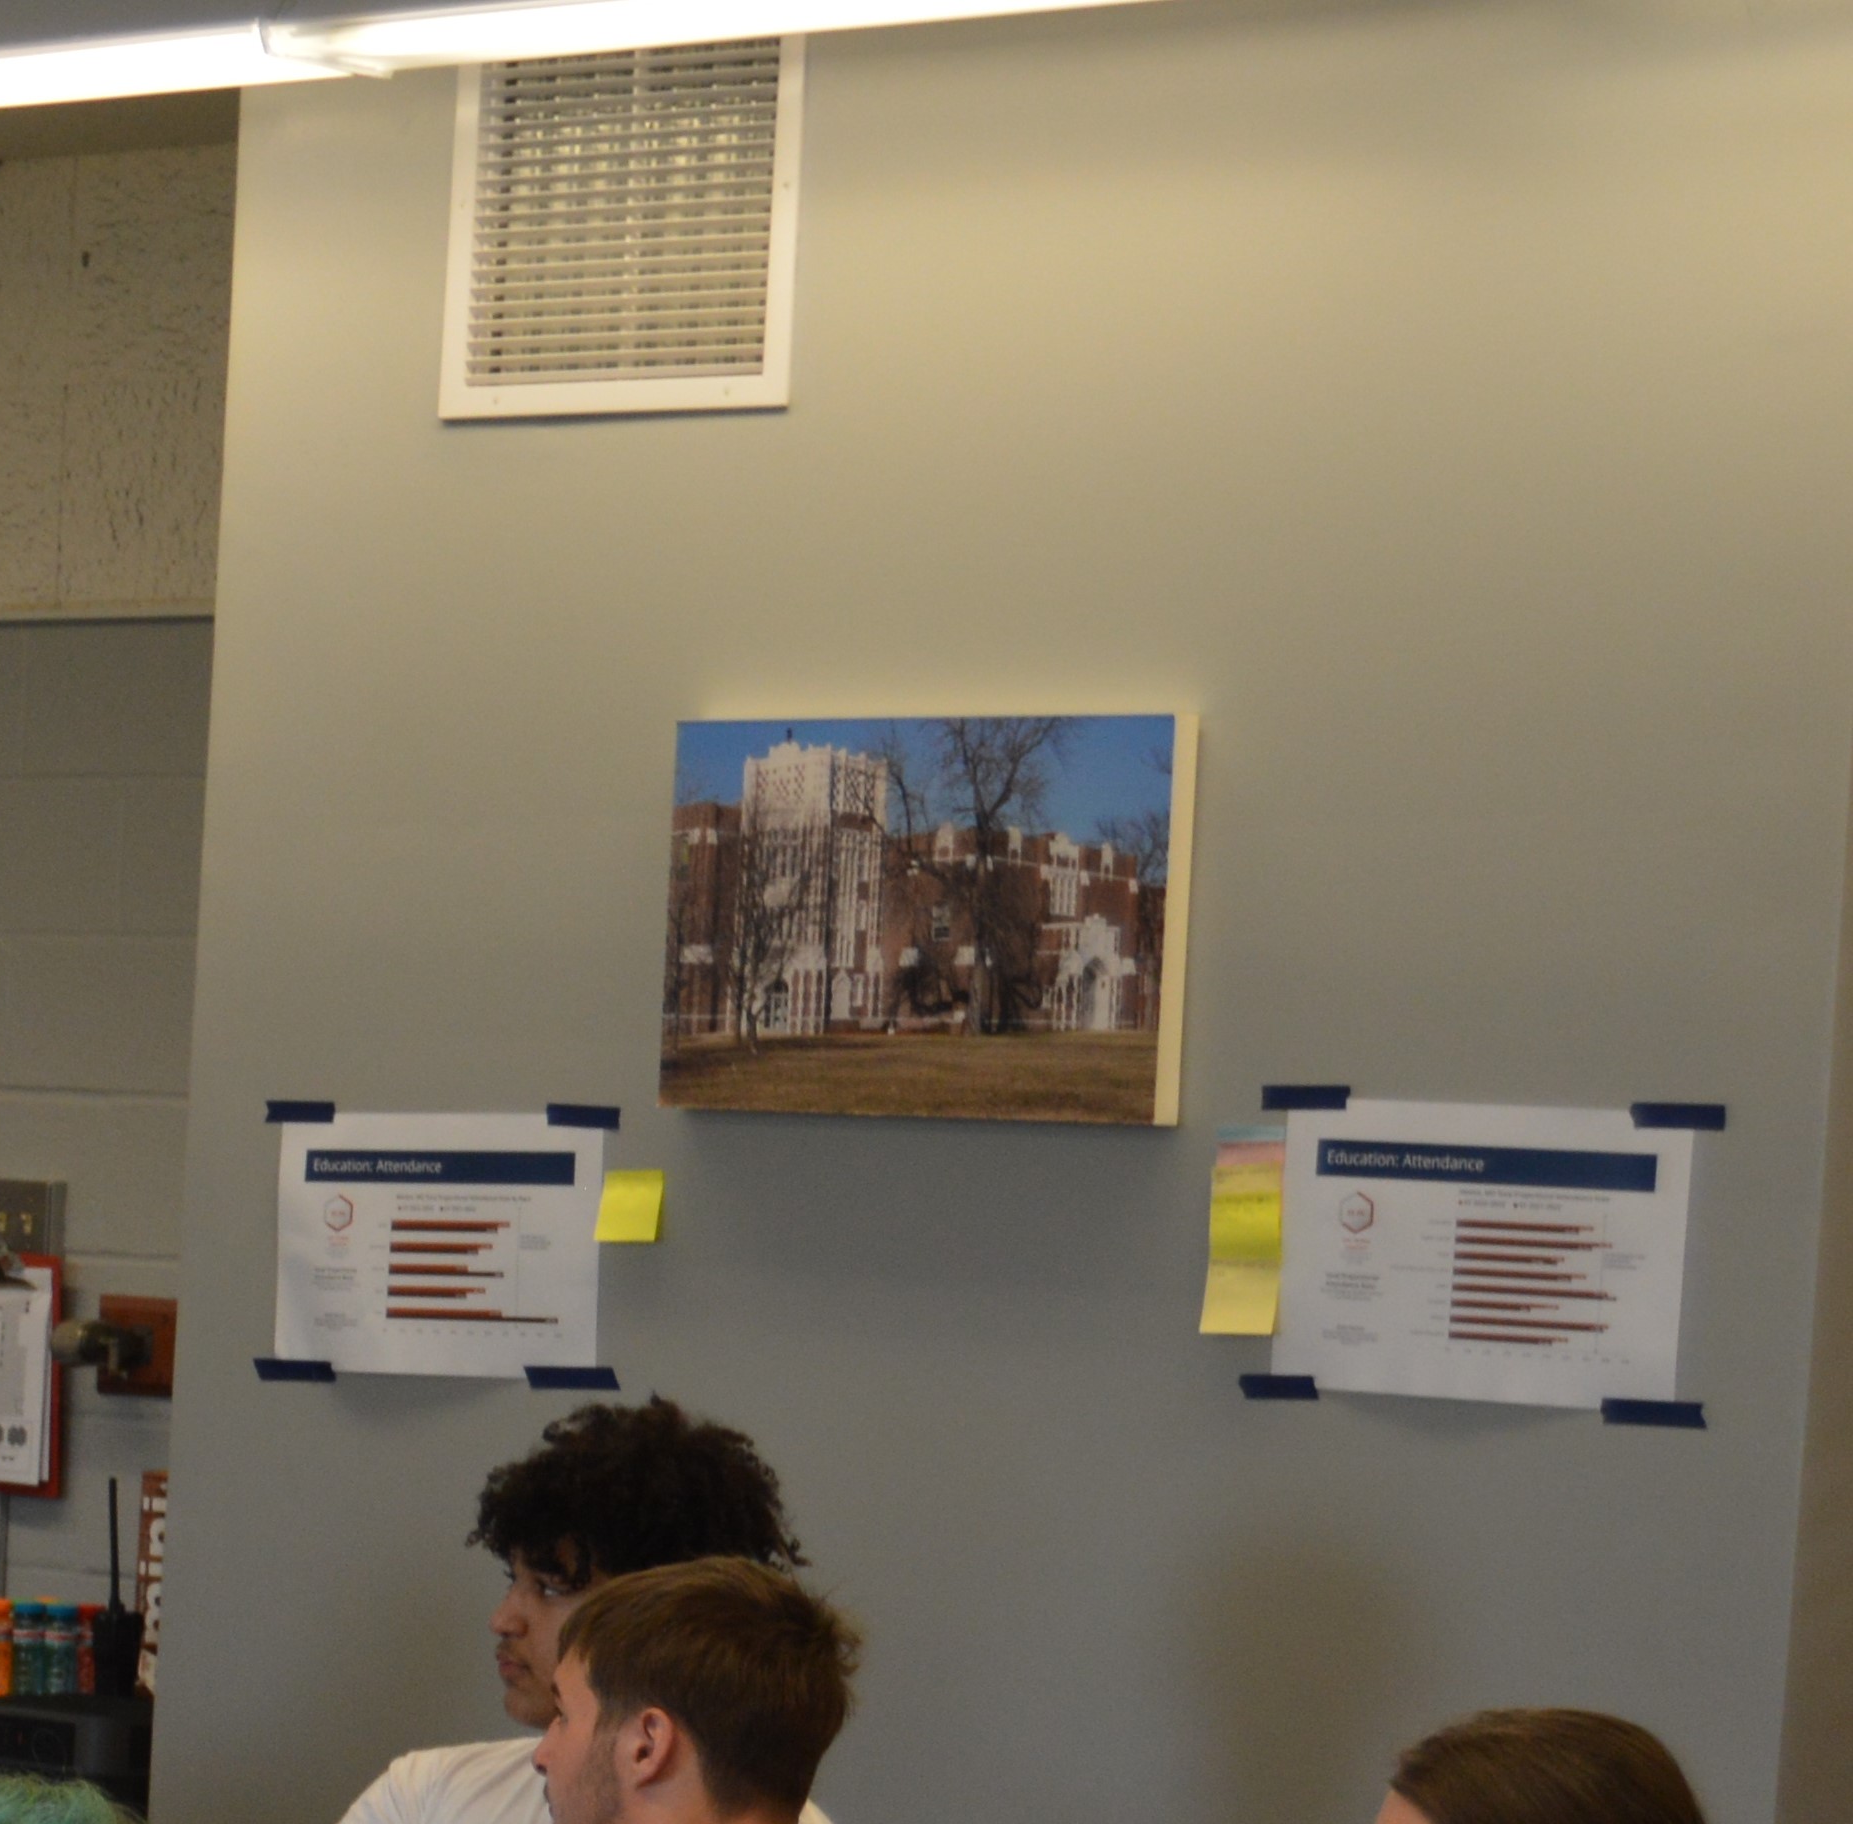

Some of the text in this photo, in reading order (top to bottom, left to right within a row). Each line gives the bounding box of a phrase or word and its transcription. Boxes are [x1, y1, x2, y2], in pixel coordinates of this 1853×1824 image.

[313, 1157, 442, 1175] Education: Attendance
[1326, 1149, 1485, 1173] Education: Attendance
